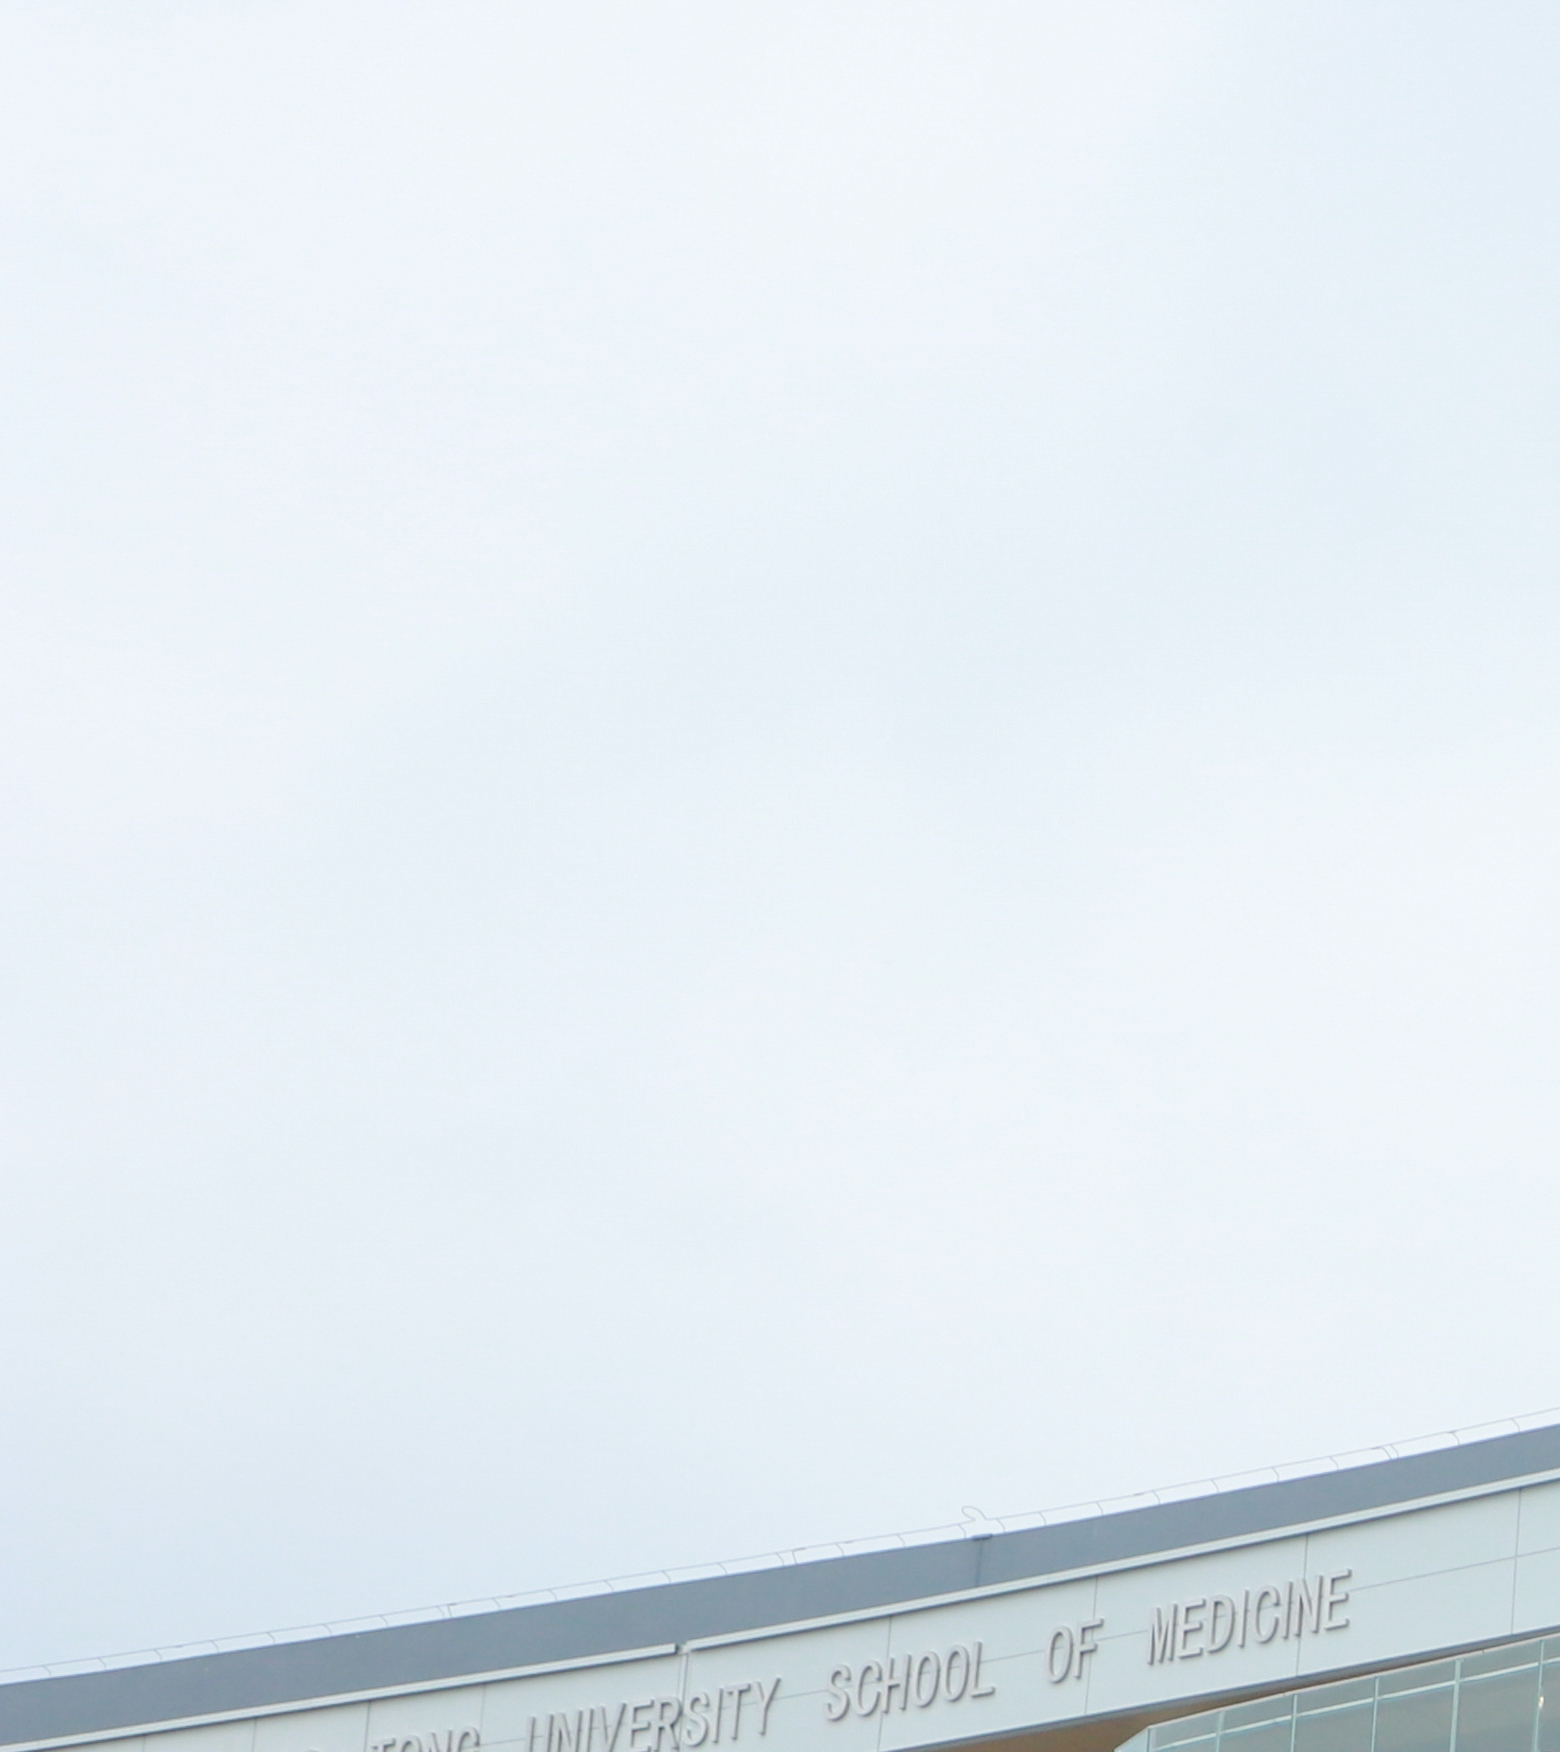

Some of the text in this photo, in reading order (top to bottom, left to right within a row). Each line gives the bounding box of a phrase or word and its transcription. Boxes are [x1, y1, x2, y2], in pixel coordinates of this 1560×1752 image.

[823, 1640, 996, 1722] SCHOOL
[1046, 1617, 1105, 1684] OF
[1145, 1568, 1353, 1667] MEDICINE
